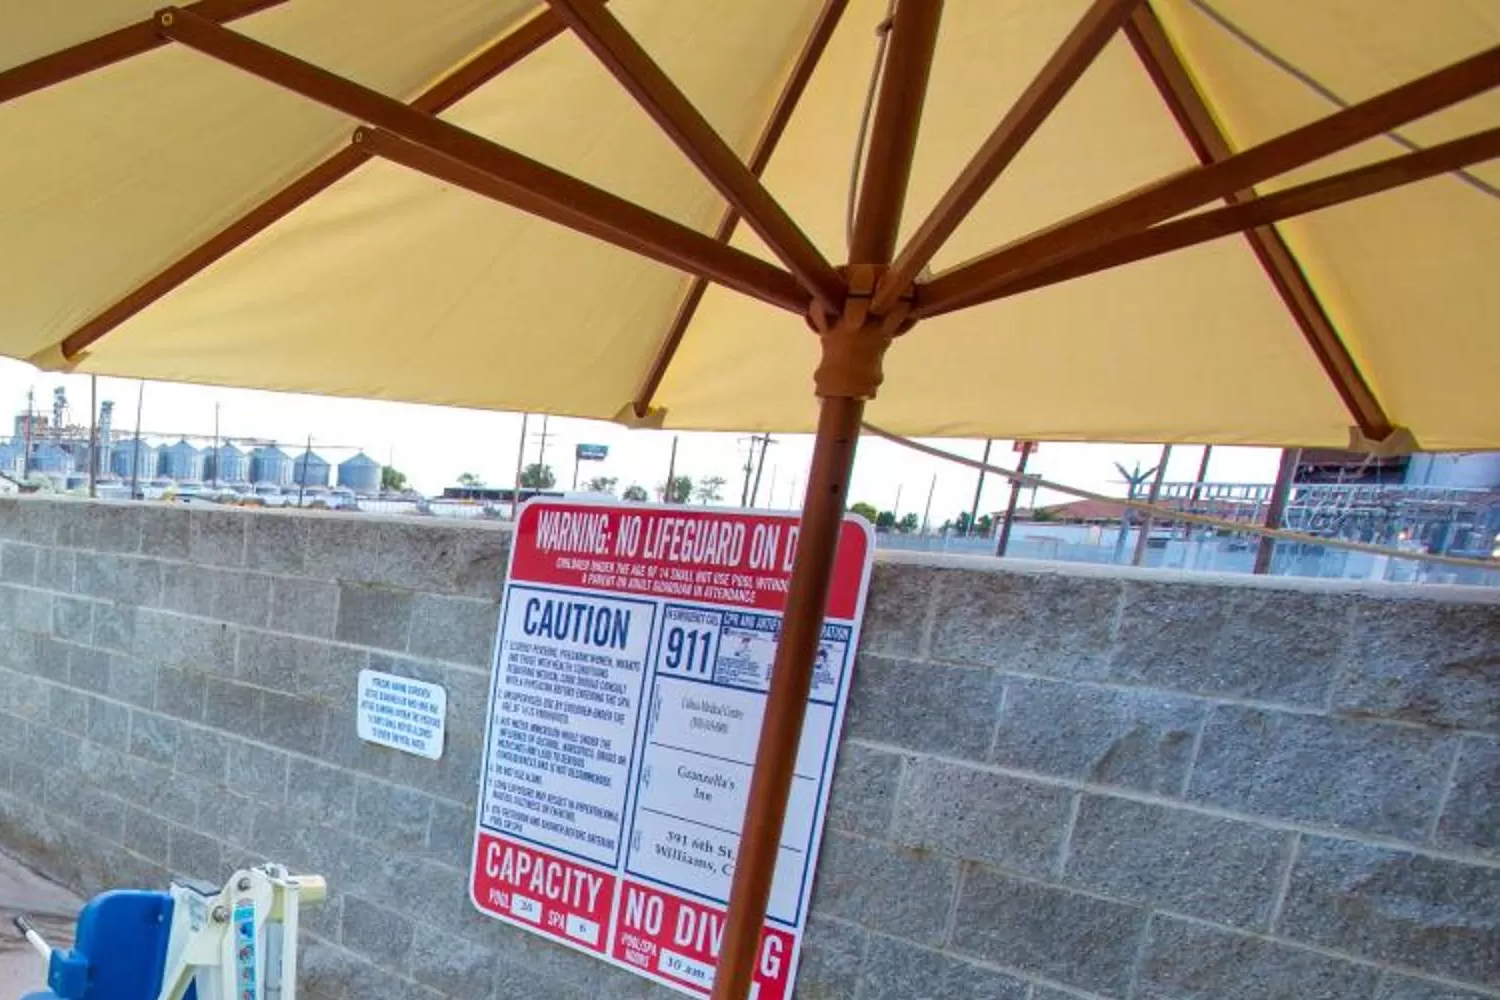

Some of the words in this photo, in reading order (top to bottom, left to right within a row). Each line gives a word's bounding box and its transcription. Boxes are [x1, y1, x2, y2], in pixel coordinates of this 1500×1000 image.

[536, 509, 612, 555] WARNING:
[615, 515, 642, 558] NO
[644, 516, 746, 567] LIFEGUARD
[749, 523, 780, 572] ON
[523, 597, 631, 651] CAUTION
[665, 627, 712, 674] 911
[486, 841, 603, 913] CAPACITY
[654, 843, 717, 873] Williams,
[547, 909, 565, 930] SPA
[624, 887, 664, 935] NO
[674, 903, 783, 980] DIVG
